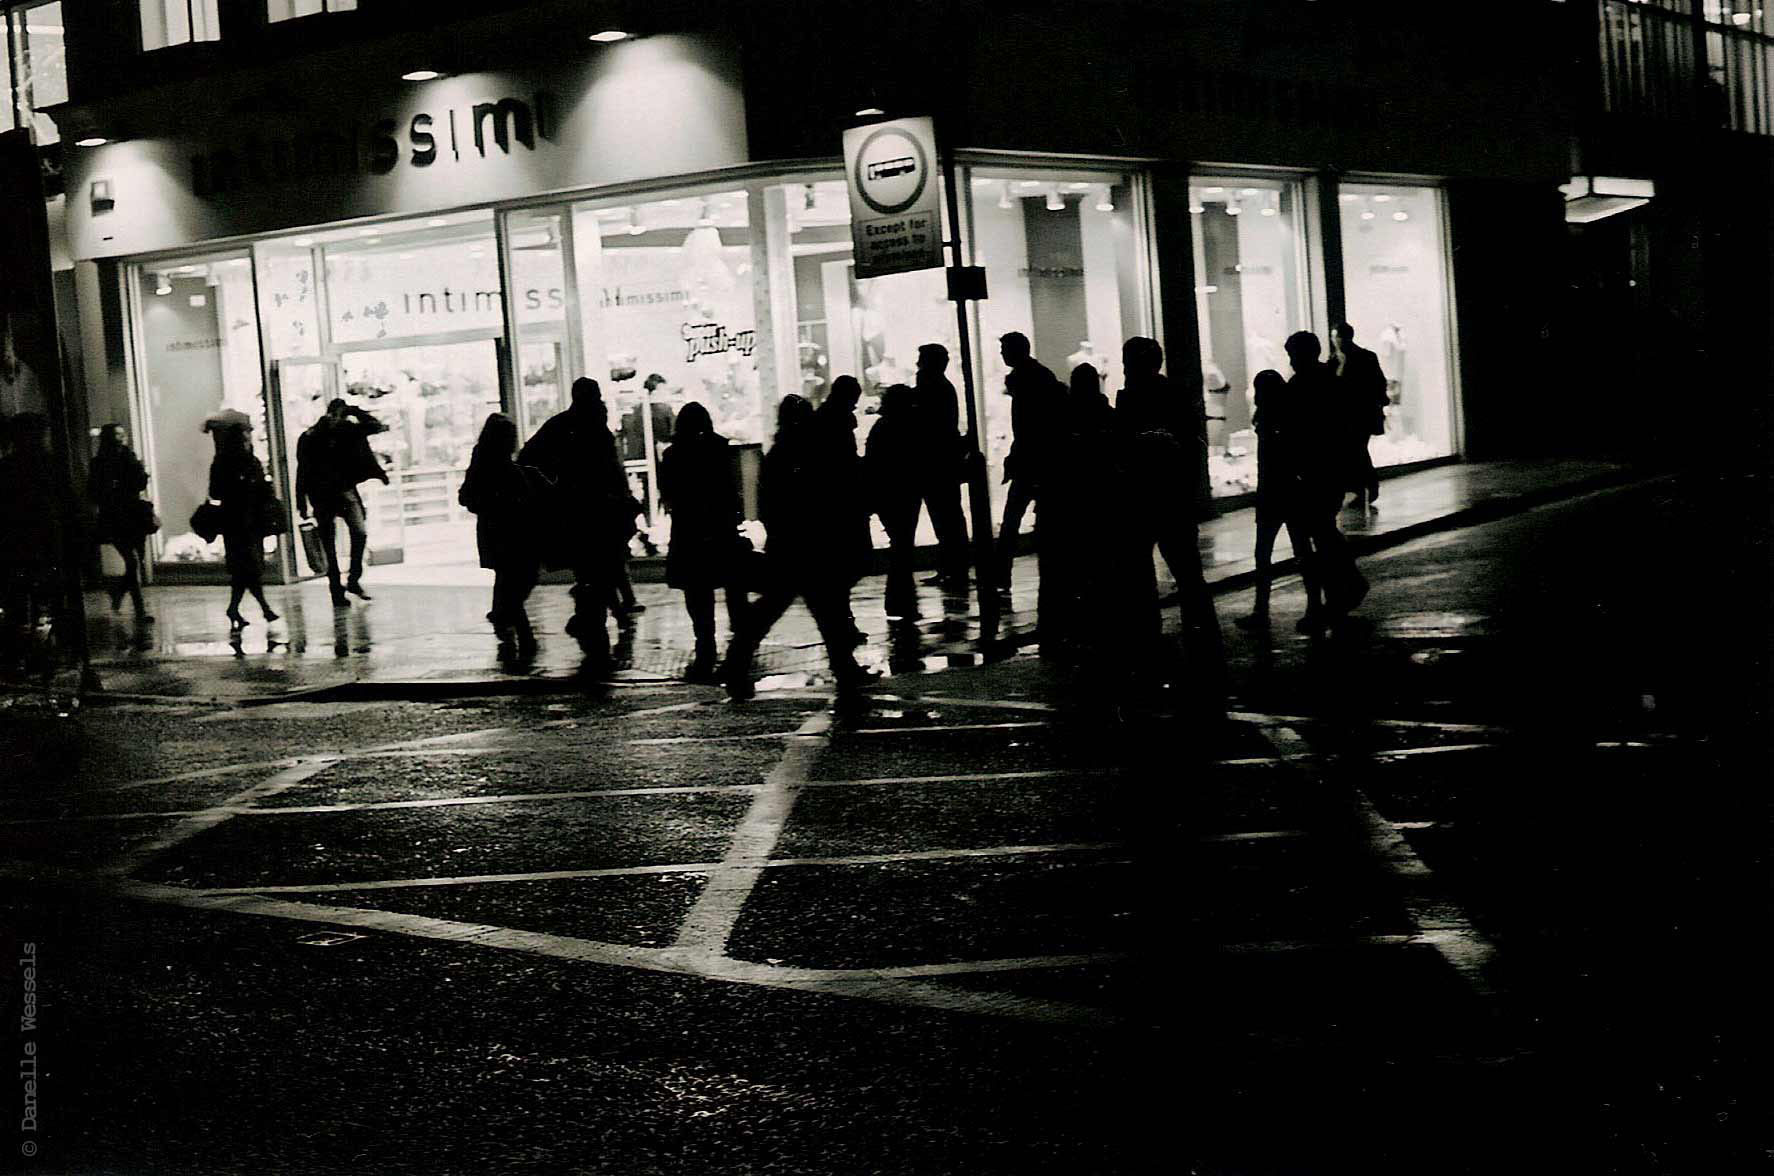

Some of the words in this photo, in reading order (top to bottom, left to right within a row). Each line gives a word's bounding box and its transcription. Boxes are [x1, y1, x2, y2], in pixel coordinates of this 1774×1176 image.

[865, 221, 906, 236] Except
[909, 218, 928, 230] for
[683, 325, 757, 363] push-up
